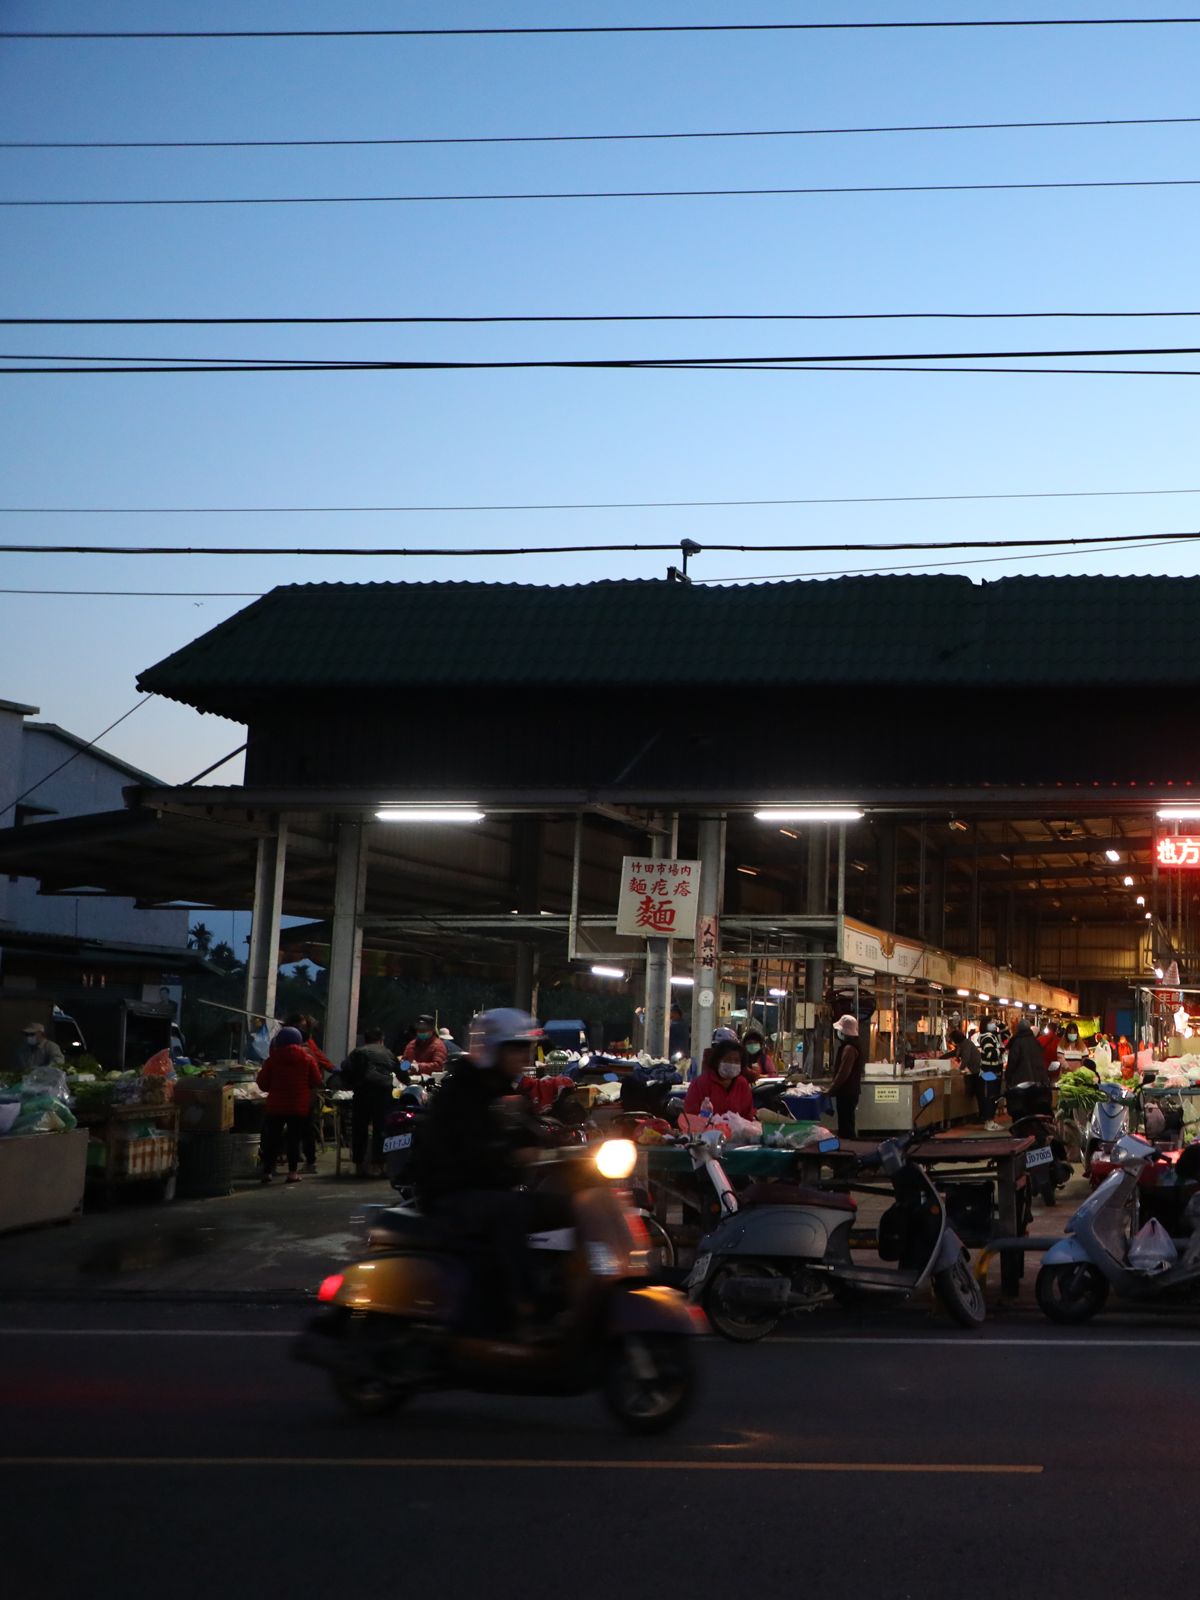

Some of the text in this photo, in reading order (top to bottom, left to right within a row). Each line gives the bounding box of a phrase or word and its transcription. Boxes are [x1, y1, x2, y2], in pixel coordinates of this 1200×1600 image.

[632, 862, 691, 877] 竹田市場內
[629, 878, 692, 897] 麵疙瘩
[635, 895, 676, 932] 麵
